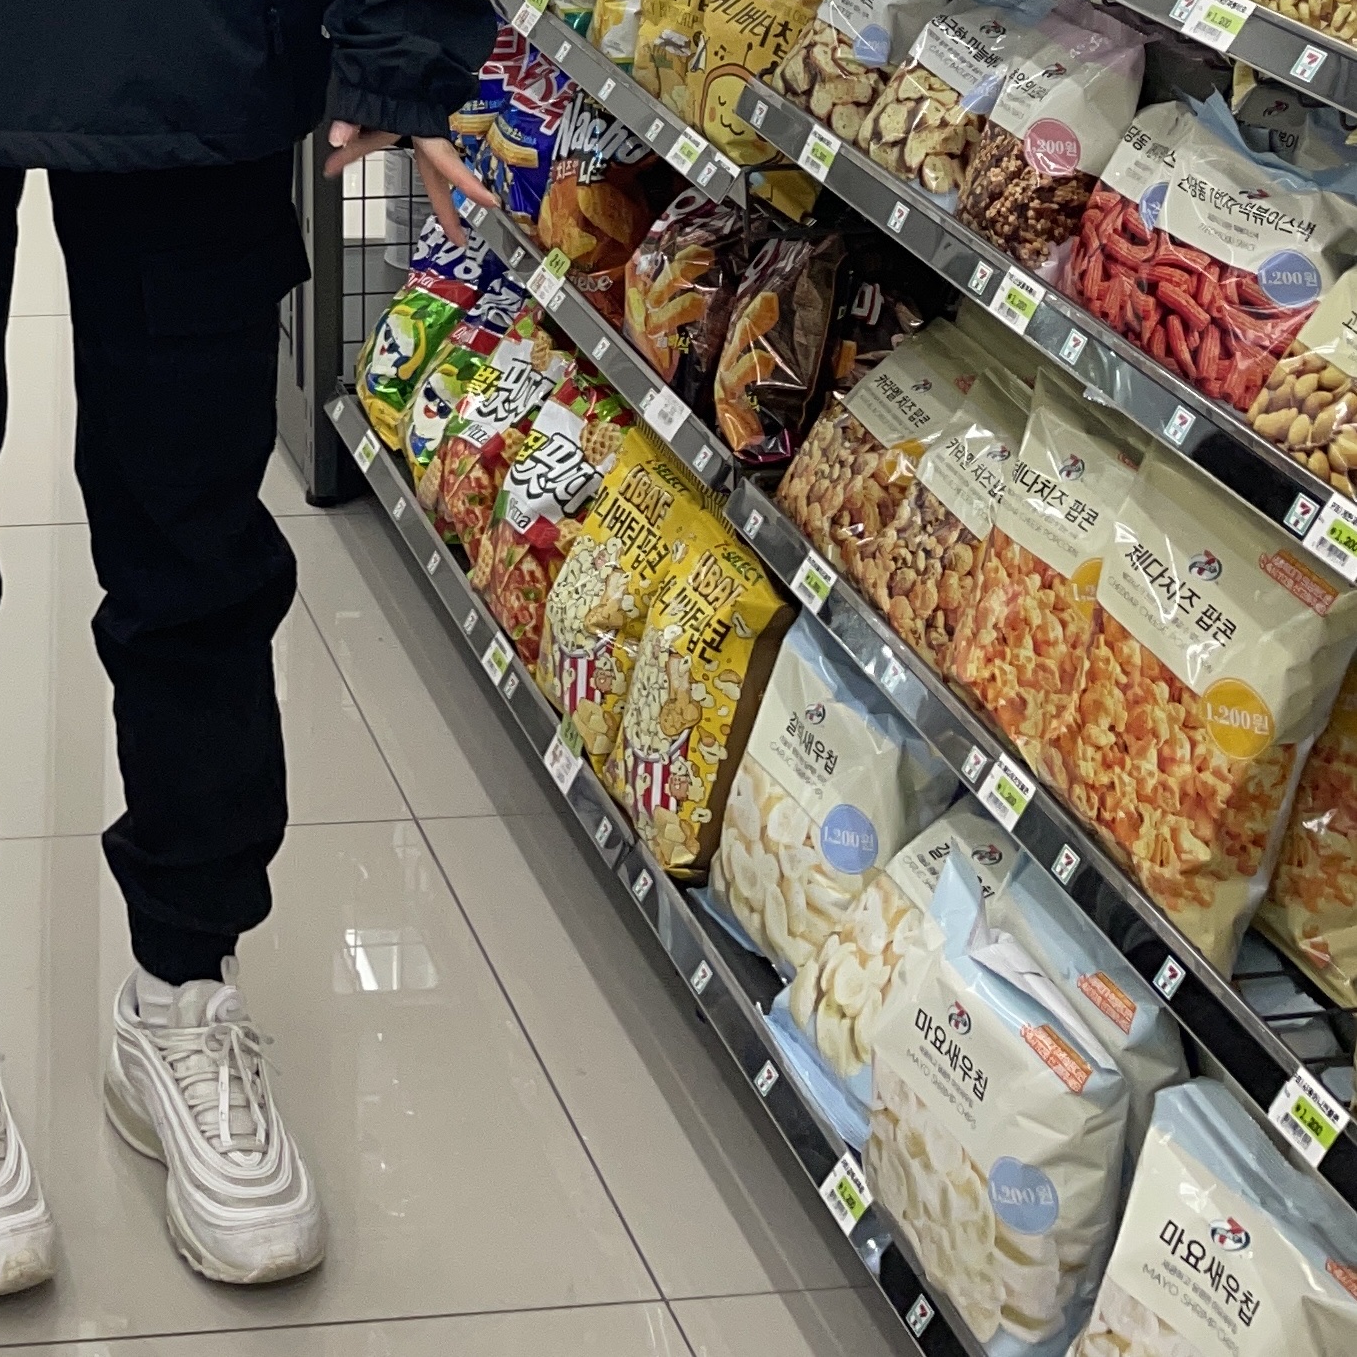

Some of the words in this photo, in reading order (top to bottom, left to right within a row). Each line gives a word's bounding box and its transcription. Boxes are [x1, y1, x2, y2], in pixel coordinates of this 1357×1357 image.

[510, 432, 605, 519] 핏자
[618, 463, 675, 526] HBAF
[1064, 499, 1100, 532] 팝콘
[1124, 543, 1202, 615] 체다치즈
[1195, 604, 1238, 647] 팝콘
[914, 1007, 989, 1102] 마요새우칩
[1159, 1219, 1260, 1327] 마요새우칩
